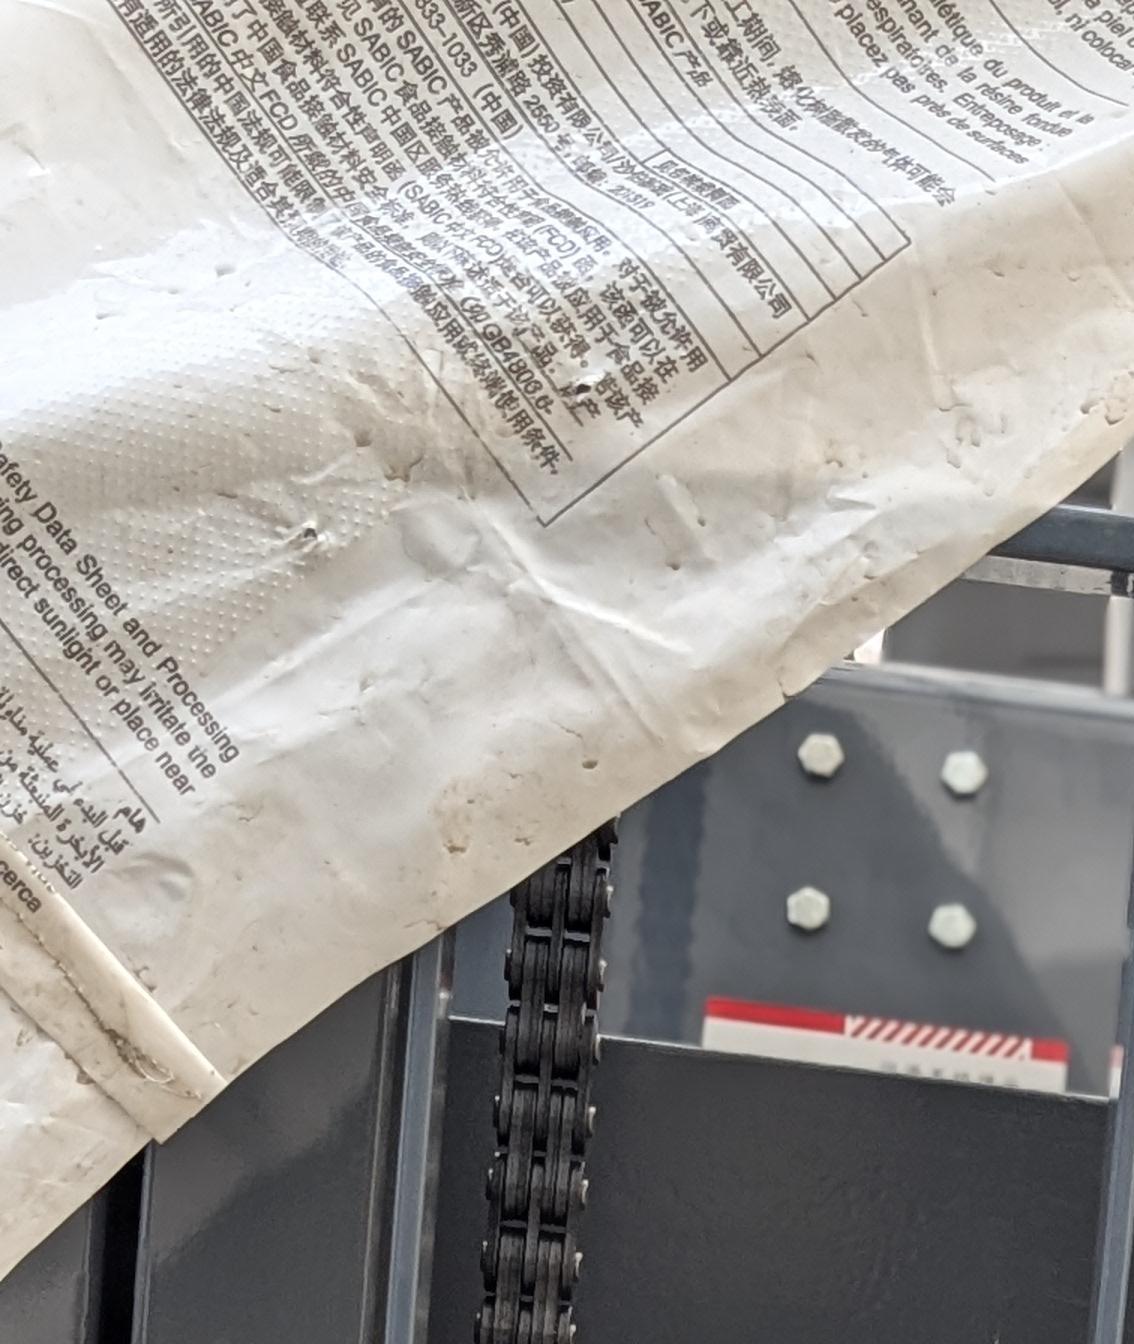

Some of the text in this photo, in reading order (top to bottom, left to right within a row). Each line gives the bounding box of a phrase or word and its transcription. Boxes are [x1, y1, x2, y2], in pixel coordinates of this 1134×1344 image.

[295, 0, 346, 49] 联系
[333, 42, 390, 108] SABIC
[351, 15, 407, 84] SABIC
[637, 0, 685, 50] ABIC
[1064, 12, 1089, 32] ni
[1093, 8, 1134, 38] piel
[191, 0, 240, 50] ABIC
[226, 46, 270, 92] 中文
[257, 87, 300, 133] FCD
[394, 29, 449, 97] SABIC
[833, 2, 1029, 166] placez pas près de surfaces
[933, 43, 961, 68] de
[956, 65, 978, 85] la
[974, 80, 1023, 116] résine
[1021, 113, 1073, 139] fondue
[981, 57, 1008, 80] du
[1001, 76, 1061, 114] produit
[1058, 109, 1080, 120] et
[1075, 111, 1095, 126] la
[522, 94, 560, 135] 2550
[951, 90, 1042, 148] Entreposage
[0, 441, 244, 764] afety Data Sheet and Processing
[0, 497, 220, 779] ing processing may irritate the
[32, 594, 102, 679] sunlight
[91, 673, 120, 702] or
[108, 696, 164, 753] place
[153, 750, 198, 799] near
[96, 825, 130, 855] قبل
[113, 803, 148, 834] هام
